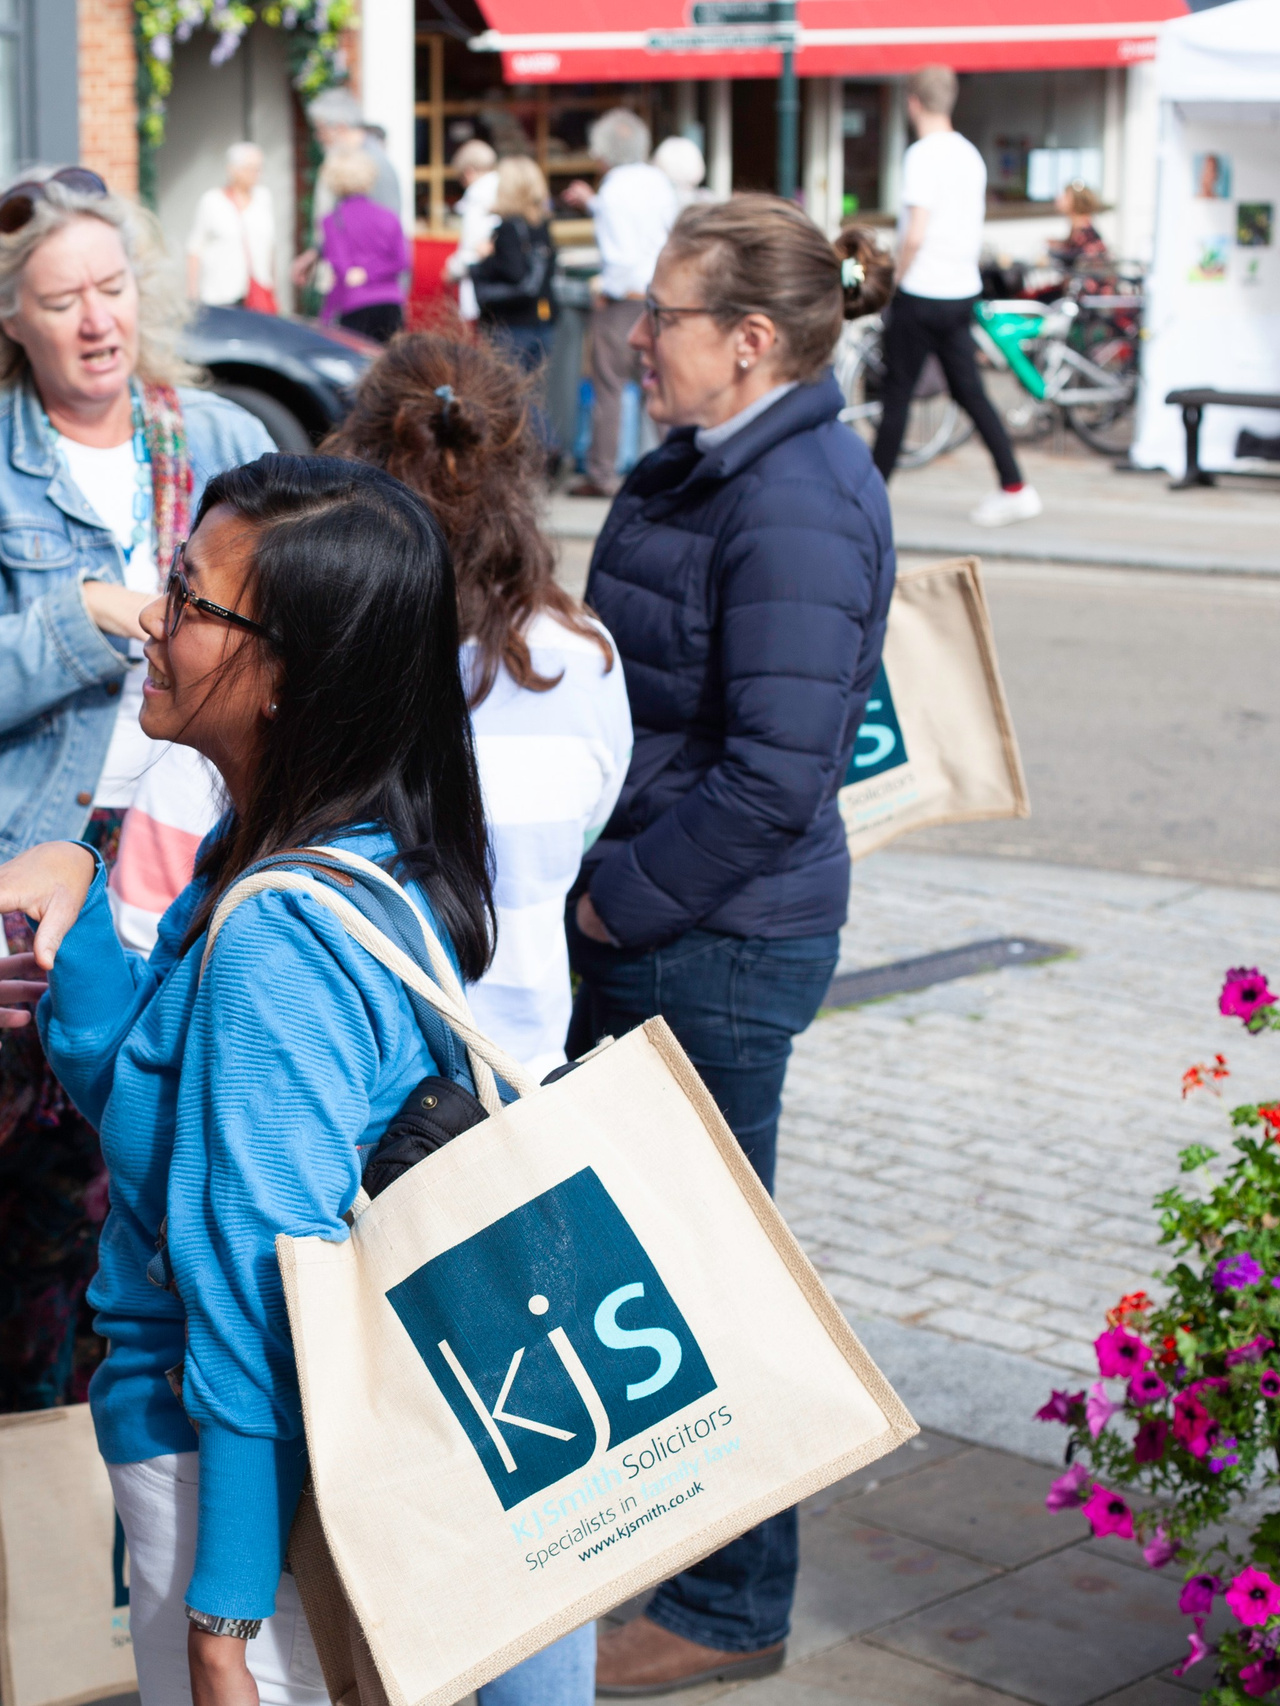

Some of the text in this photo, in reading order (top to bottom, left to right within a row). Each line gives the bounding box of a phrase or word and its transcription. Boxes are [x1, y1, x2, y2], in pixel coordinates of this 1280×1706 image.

[437, 1282, 683, 1474] kjs
[510, 1405, 732, 1544] KJSmith Solicitors
[525, 1436, 740, 1570] Specialists in family law
[578, 1482, 705, 1562] www.kjsmith.co.uk
